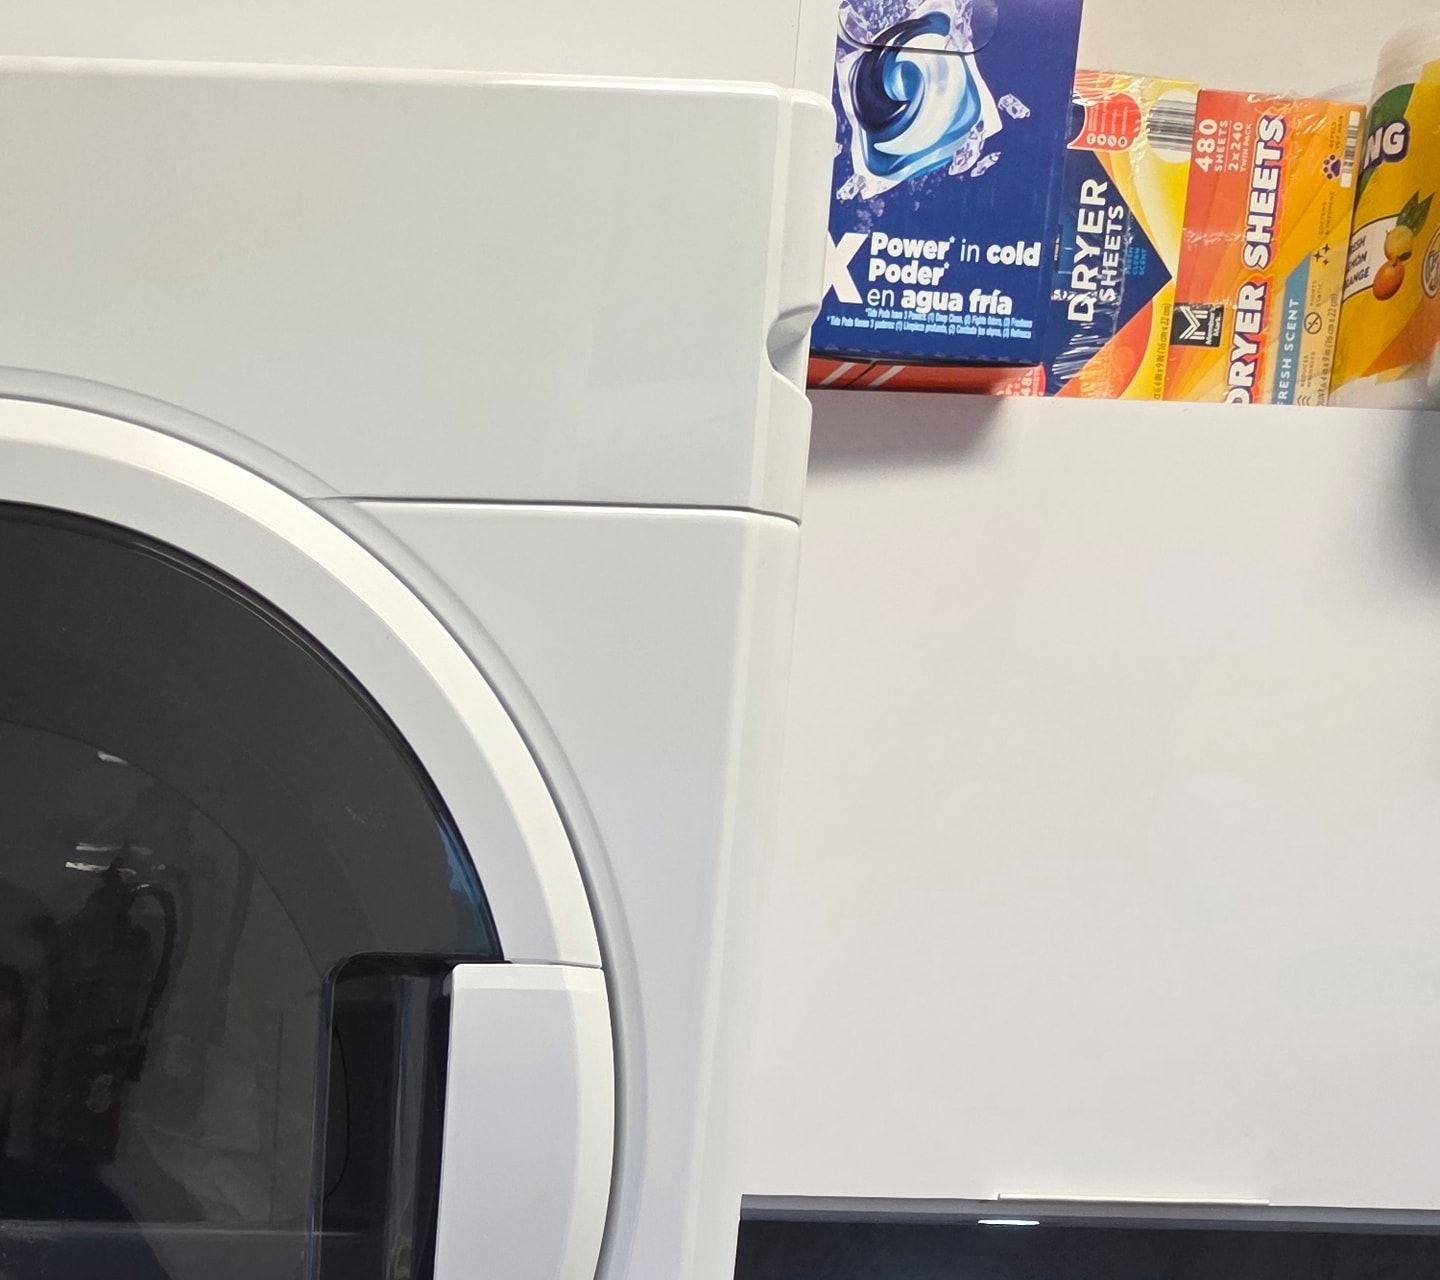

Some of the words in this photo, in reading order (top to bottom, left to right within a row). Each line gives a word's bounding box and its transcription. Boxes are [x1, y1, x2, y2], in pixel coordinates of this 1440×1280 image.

[1195, 119, 1218, 173] 480
[1214, 120, 1229, 172] SHEETS
[1240, 147, 1249, 172] TWIN
[1244, 123, 1253, 147] PACK
[1244, 116, 1285, 269] SHEETS
[960, 238, 980, 263] in
[986, 241, 1042, 267] cold
[1068, 179, 1108, 322] DRYER
[1099, 205, 1124, 302] SHEETS
[867, 289, 895, 307] en
[901, 289, 963, 314] agua
[969, 288, 1013, 315] fría
[1285, 298, 1299, 352] SCENT
